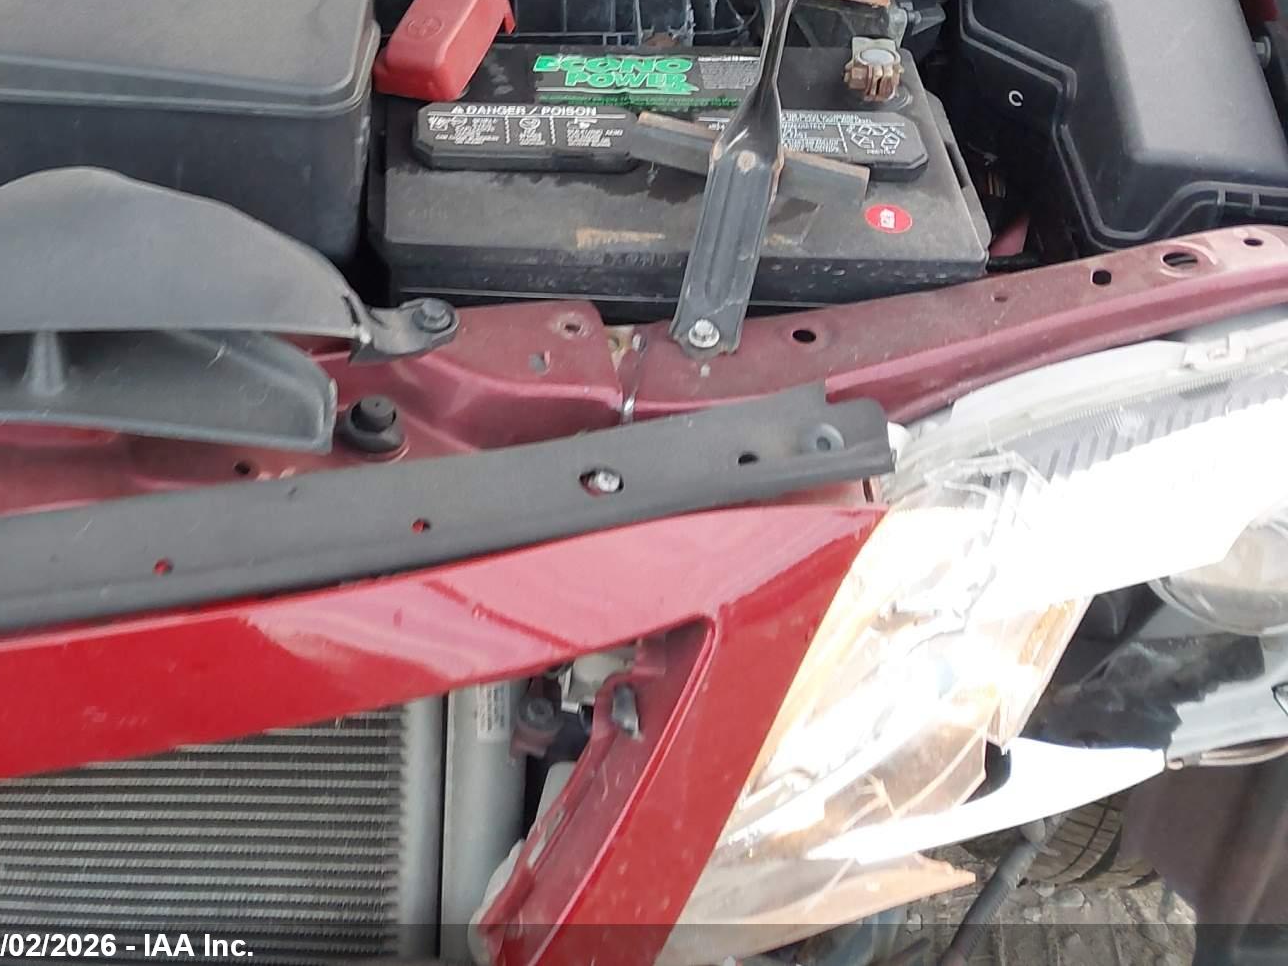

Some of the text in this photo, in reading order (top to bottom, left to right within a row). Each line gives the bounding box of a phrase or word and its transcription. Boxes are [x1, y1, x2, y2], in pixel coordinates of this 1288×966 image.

[533, 55, 693, 74] ECONO
[564, 71, 692, 92] POWER
[465, 105, 527, 117] DANGER
[541, 105, 597, 117] POISON
